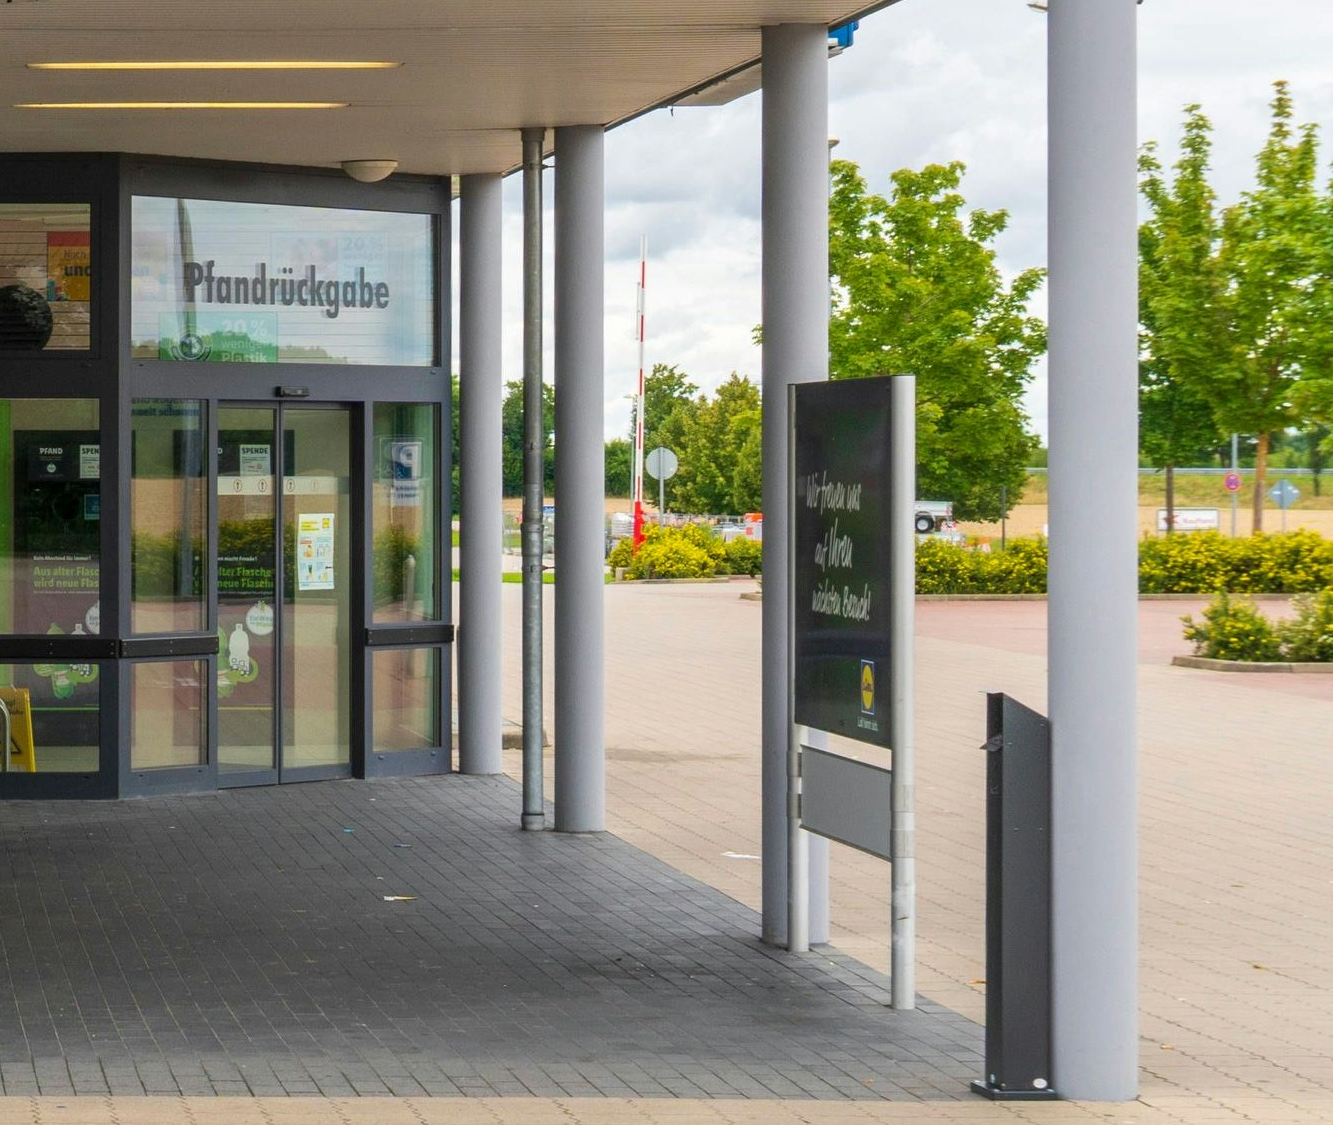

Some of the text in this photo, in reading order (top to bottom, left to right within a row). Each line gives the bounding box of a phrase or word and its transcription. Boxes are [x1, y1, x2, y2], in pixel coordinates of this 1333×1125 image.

[184, 260, 389, 318] Pfandrückgabe
[39, 447, 63, 455] PFAND
[806, 472, 820, 508] Wir
[829, 517, 852, 568] Ihren
[34, 566, 51, 576] Aus
[53, 566, 75, 576] alter
[217, 567, 272, 576] lter Flasche
[34, 577, 54, 587] wird
[56, 578, 79, 587] neue
